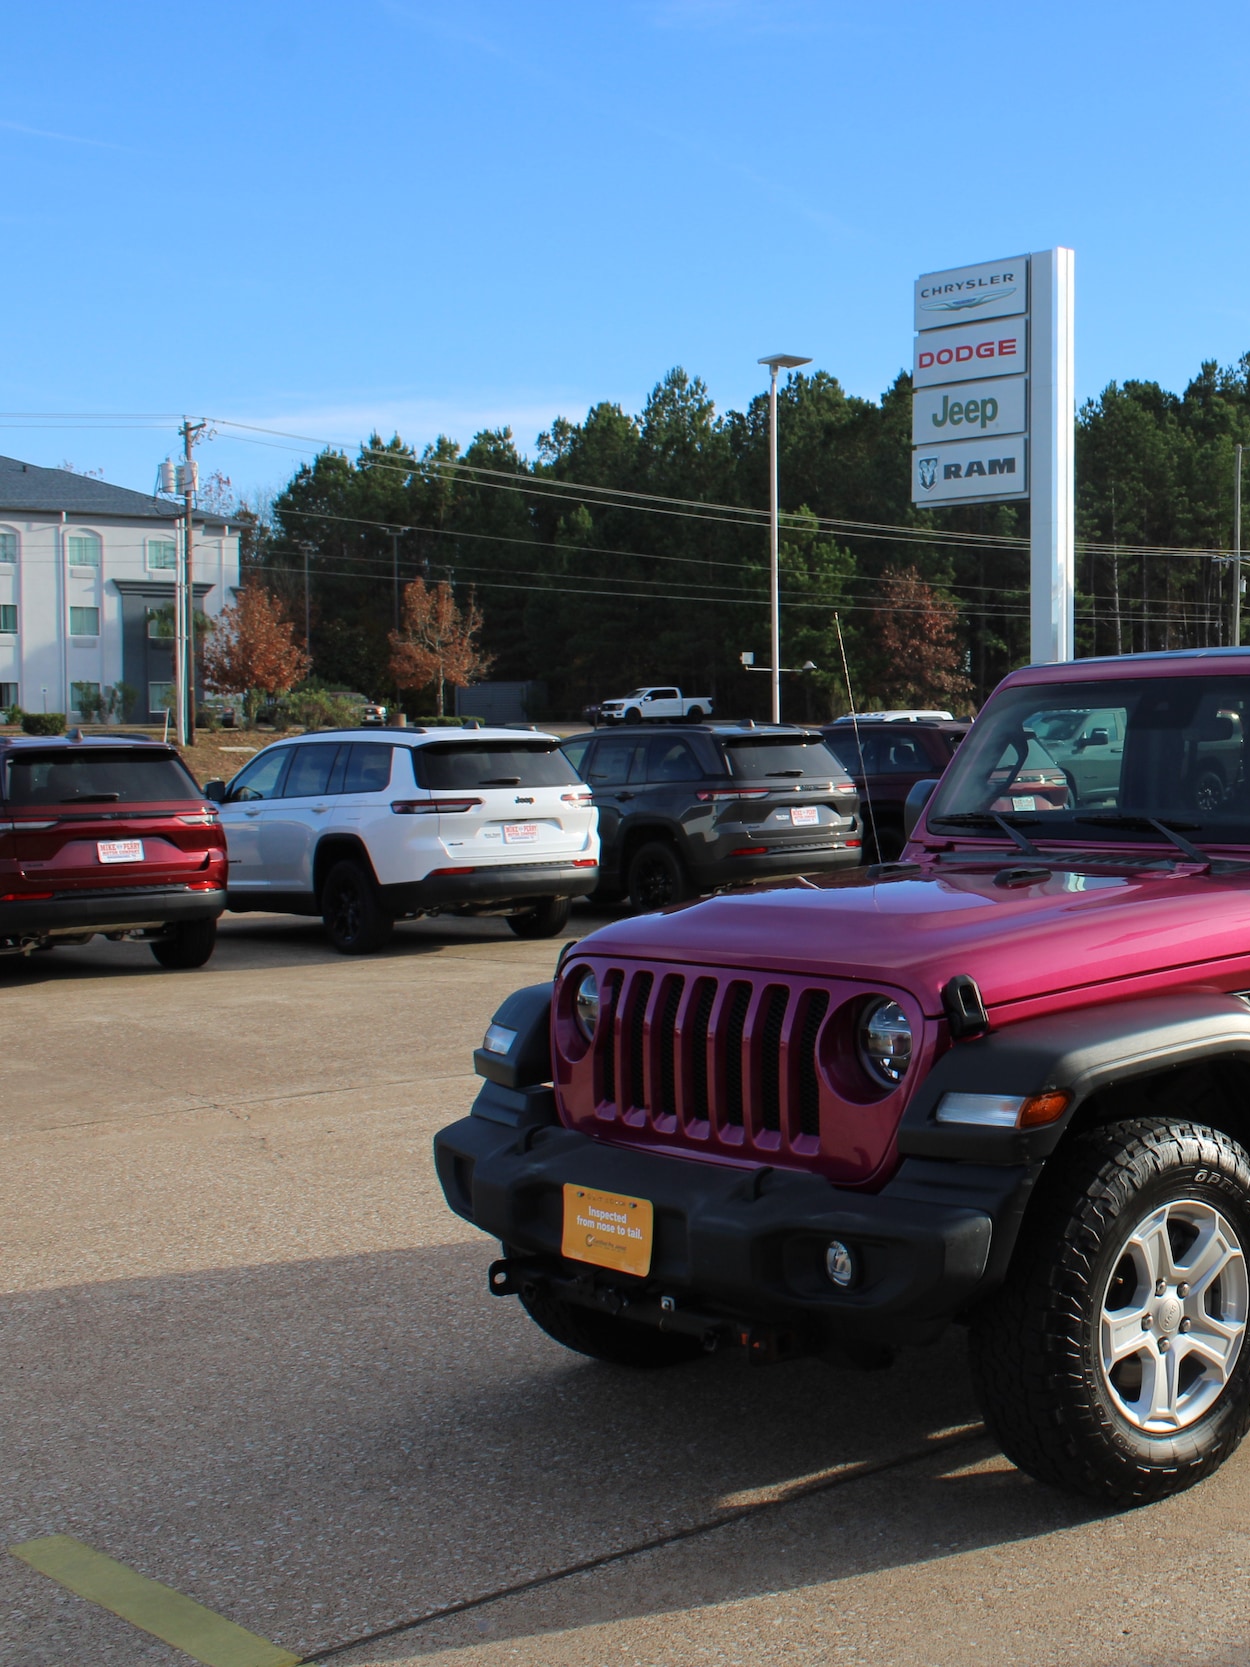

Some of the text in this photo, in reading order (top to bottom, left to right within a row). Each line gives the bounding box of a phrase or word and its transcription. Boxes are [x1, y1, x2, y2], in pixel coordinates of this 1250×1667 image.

[920, 273, 1015, 298] CHRYSLER
[919, 338, 1017, 369] DODGE
[932, 395, 998, 428] Jeep
[943, 457, 1016, 480] RAM
[589, 1205, 627, 1224] Inspected
[577, 1215, 642, 1240] from nose to tail.
